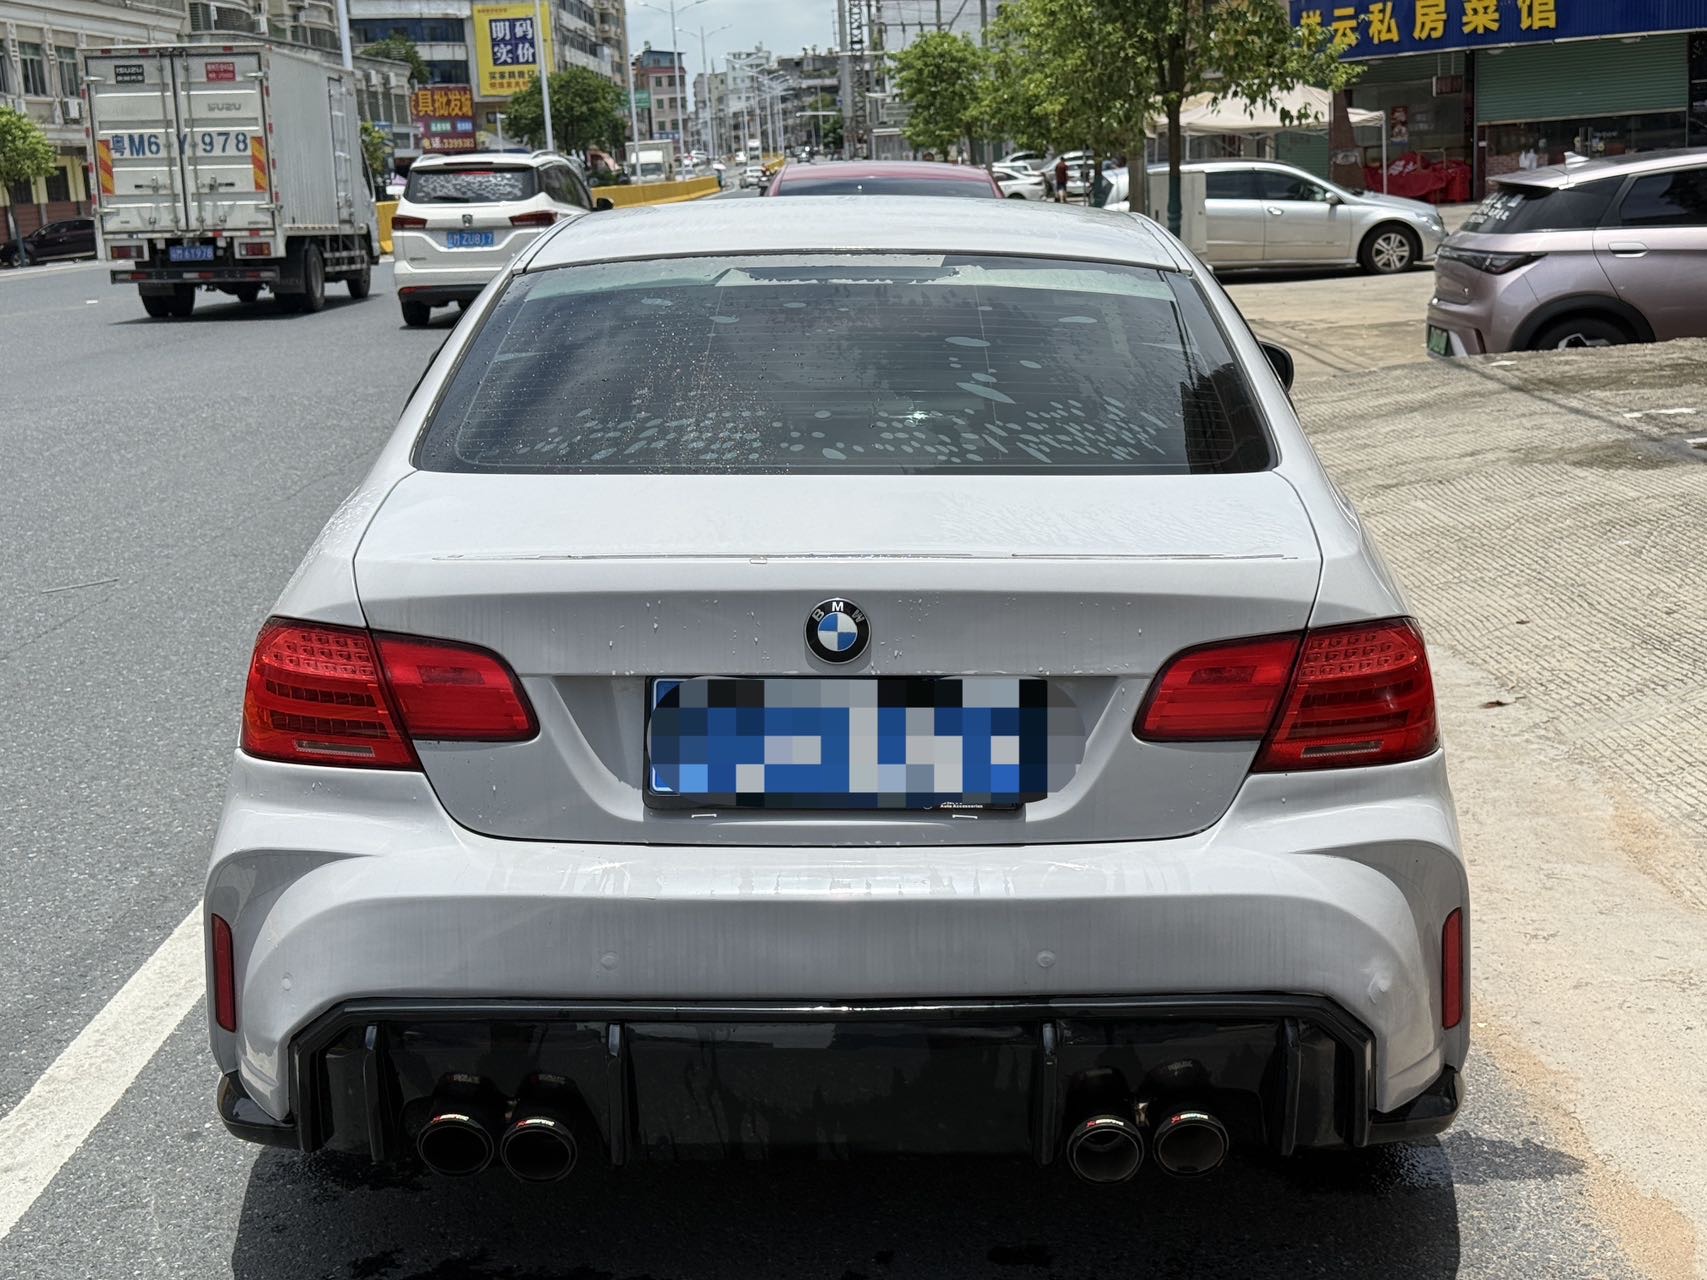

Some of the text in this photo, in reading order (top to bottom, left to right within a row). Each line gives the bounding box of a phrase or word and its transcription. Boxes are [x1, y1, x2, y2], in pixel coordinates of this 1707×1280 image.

[491, 20, 533, 41] 明码
[493, 43, 535, 65] 实价
[811, 601, 865, 623] BMW
